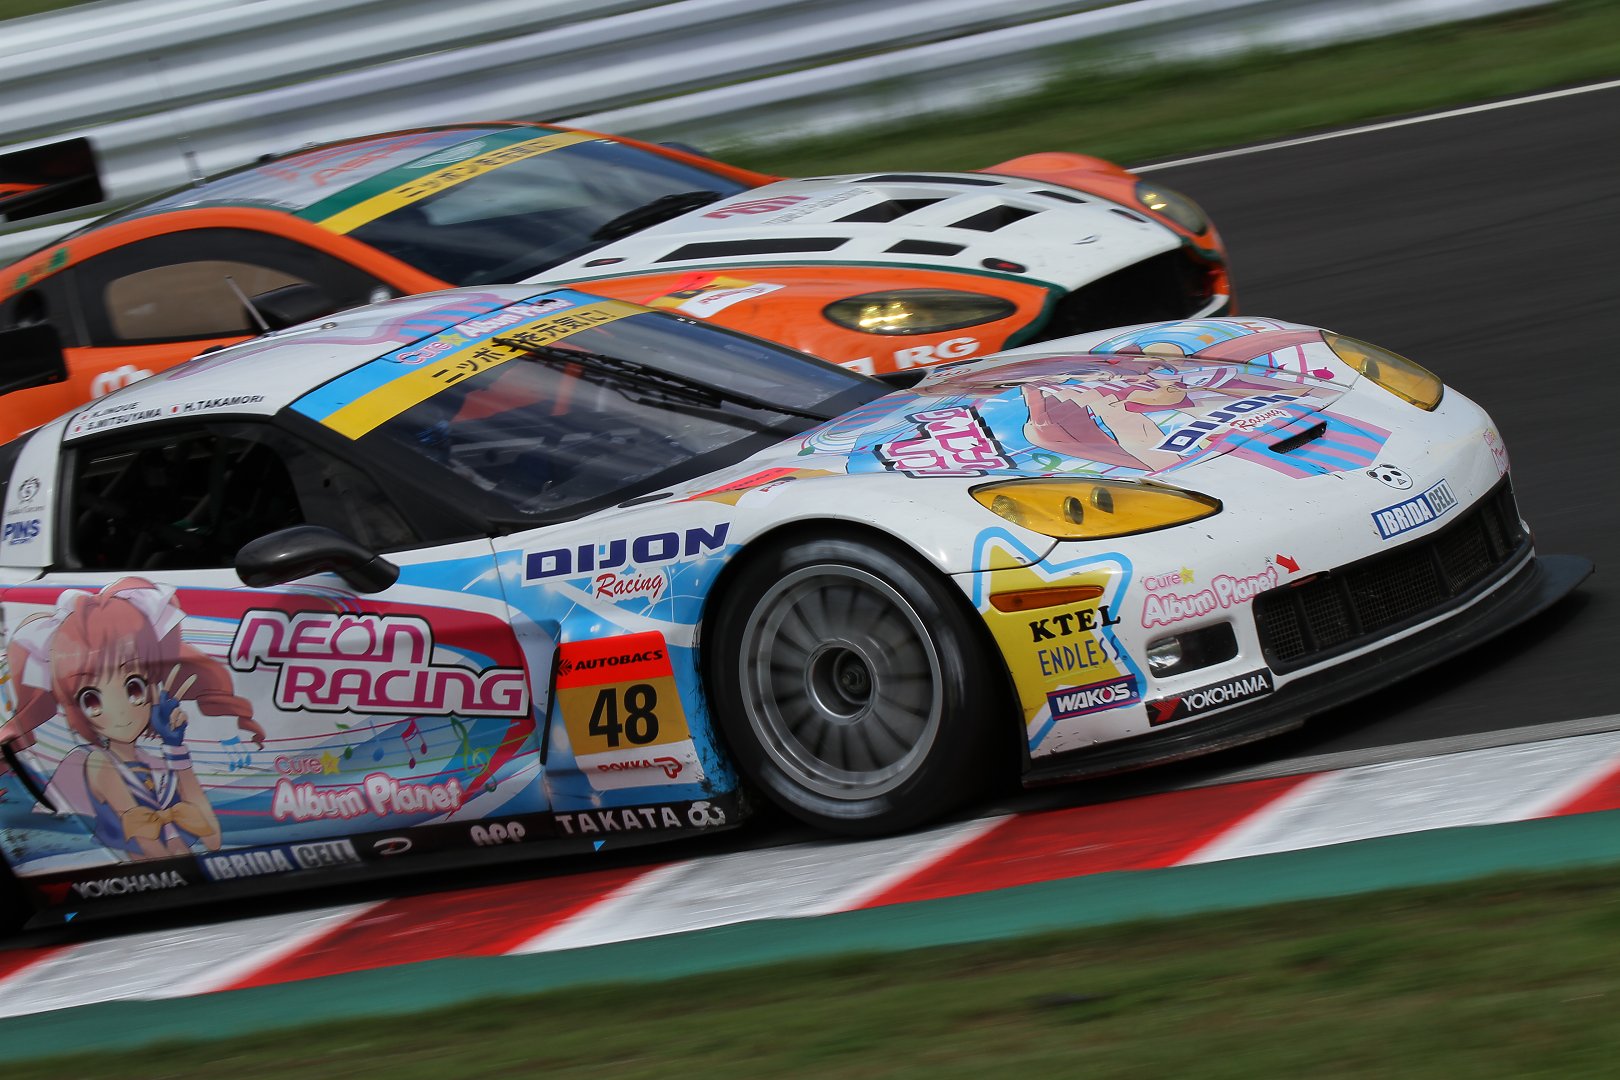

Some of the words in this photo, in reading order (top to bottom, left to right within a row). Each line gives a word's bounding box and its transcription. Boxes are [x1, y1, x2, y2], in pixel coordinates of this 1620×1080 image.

[894, 336, 981, 370] RG
[183, 395, 265, 413] H.TAKAMORI
[1157, 394, 1299, 452] DIJON
[1376, 497, 1434, 536] IBRIDA
[1428, 483, 1455, 513] CELL
[526, 522, 730, 580] DIJON
[595, 573, 663, 599] Racing
[1141, 588, 1216, 629] Album
[1211, 566, 1279, 609] Planet
[1144, 573, 1182, 592] Cure
[1029, 605, 1121, 642] KTEL
[575, 650, 663, 671] AUTOBACS
[1038, 635, 1120, 676] ENDLESS
[282, 665, 526, 710] RACING
[1181, 674, 1269, 712] YOKOHAMA
[588, 683, 660, 748] 48
[274, 755, 323, 775] Cure
[273, 777, 368, 822] Album
[364, 771, 465, 817] Planet
[555, 806, 683, 835] TAKATA
[72, 870, 188, 900] YOKOHAMA
[205, 849, 294, 881] IBRIDA
[297, 842, 356, 871] CELL
